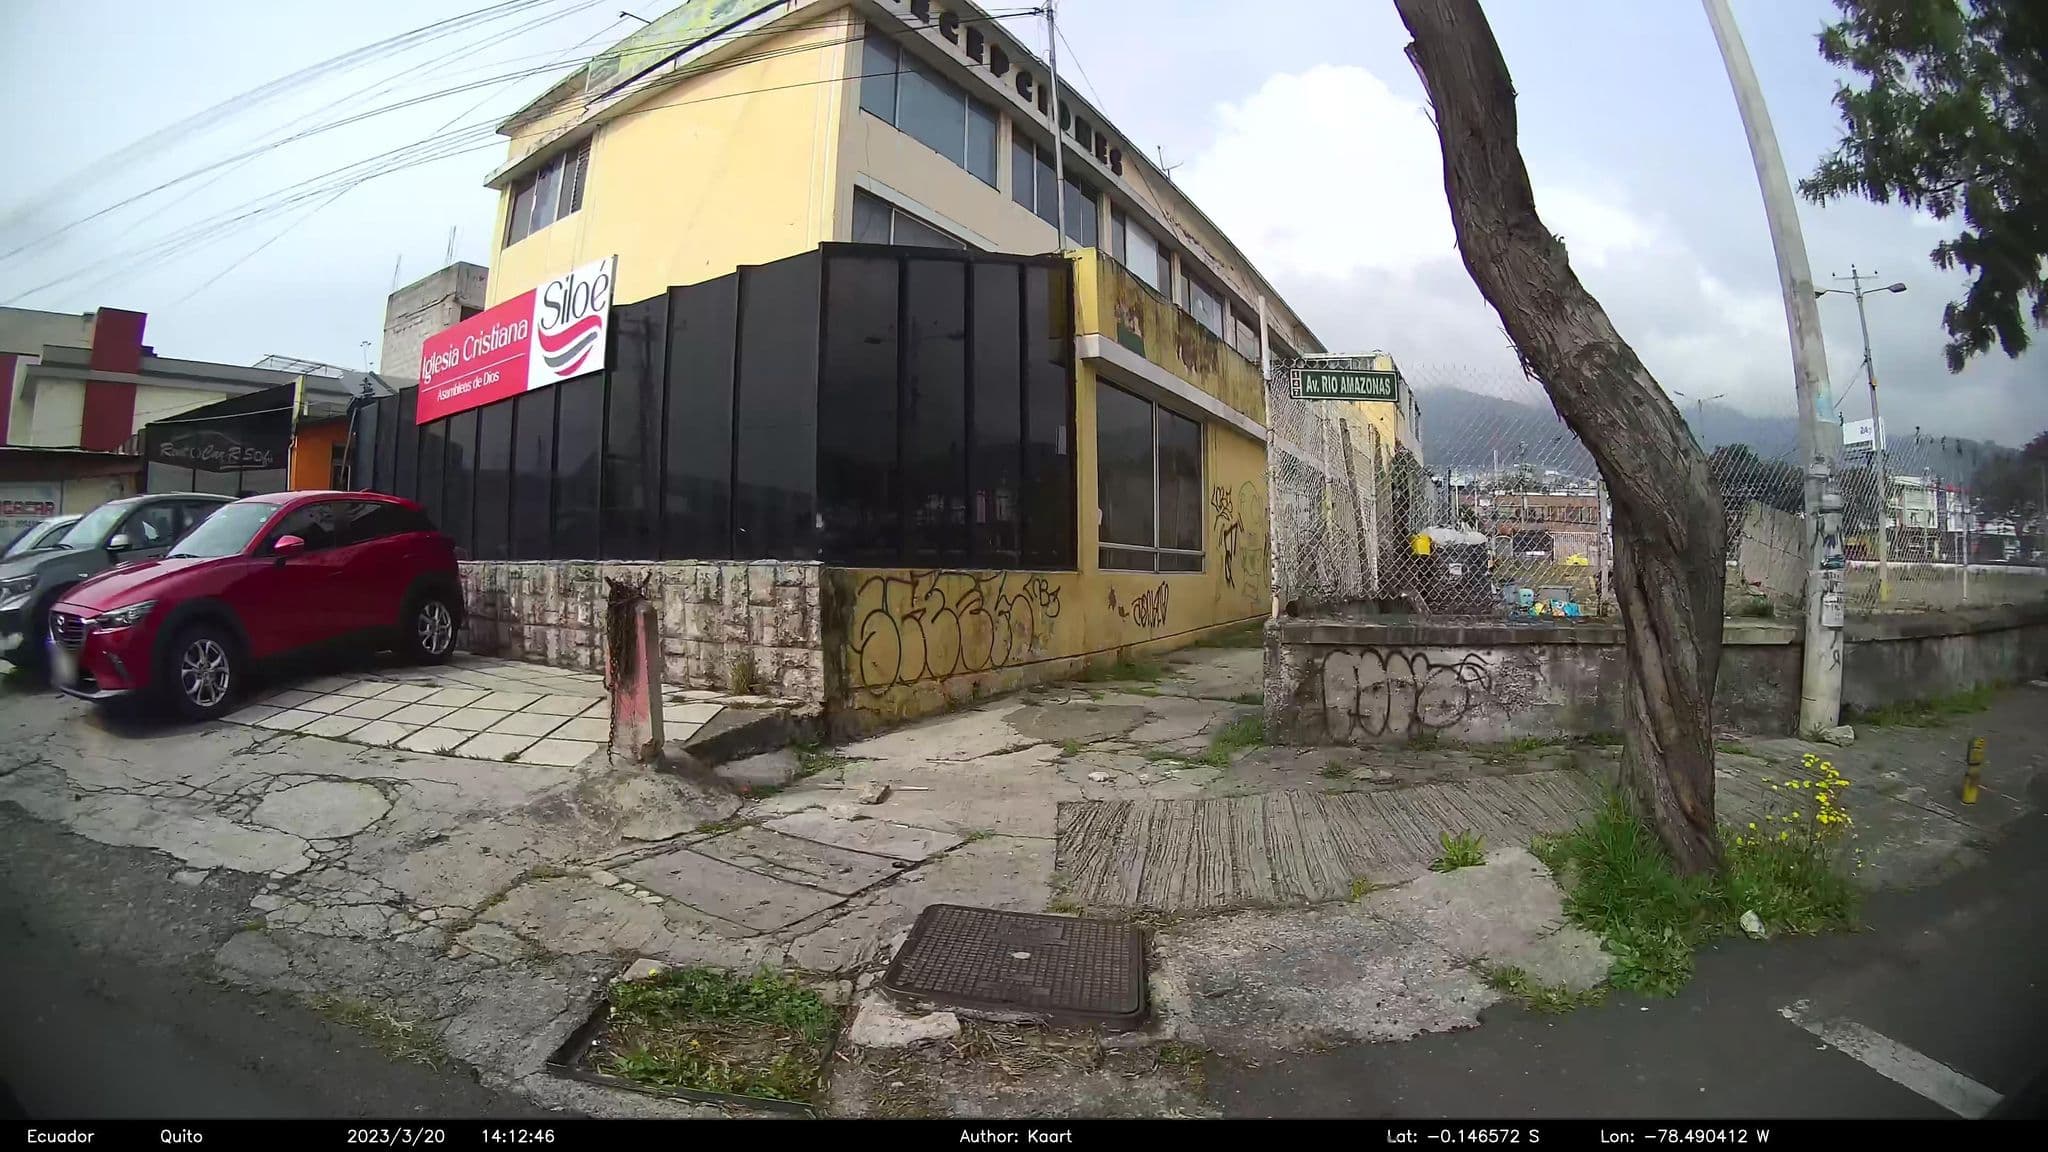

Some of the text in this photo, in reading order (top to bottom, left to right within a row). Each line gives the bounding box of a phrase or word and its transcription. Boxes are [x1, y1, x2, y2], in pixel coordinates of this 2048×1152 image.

[893, 0, 1123, 176] ECEPCIONES
[541, 260, 609, 330] Siloé
[422, 319, 529, 384] Iglesia Cristiana
[472, 376, 483, 389] de
[483, 370, 500, 386] Dios
[1306, 375, 1391, 396] Av. RIO AMAZONAS
